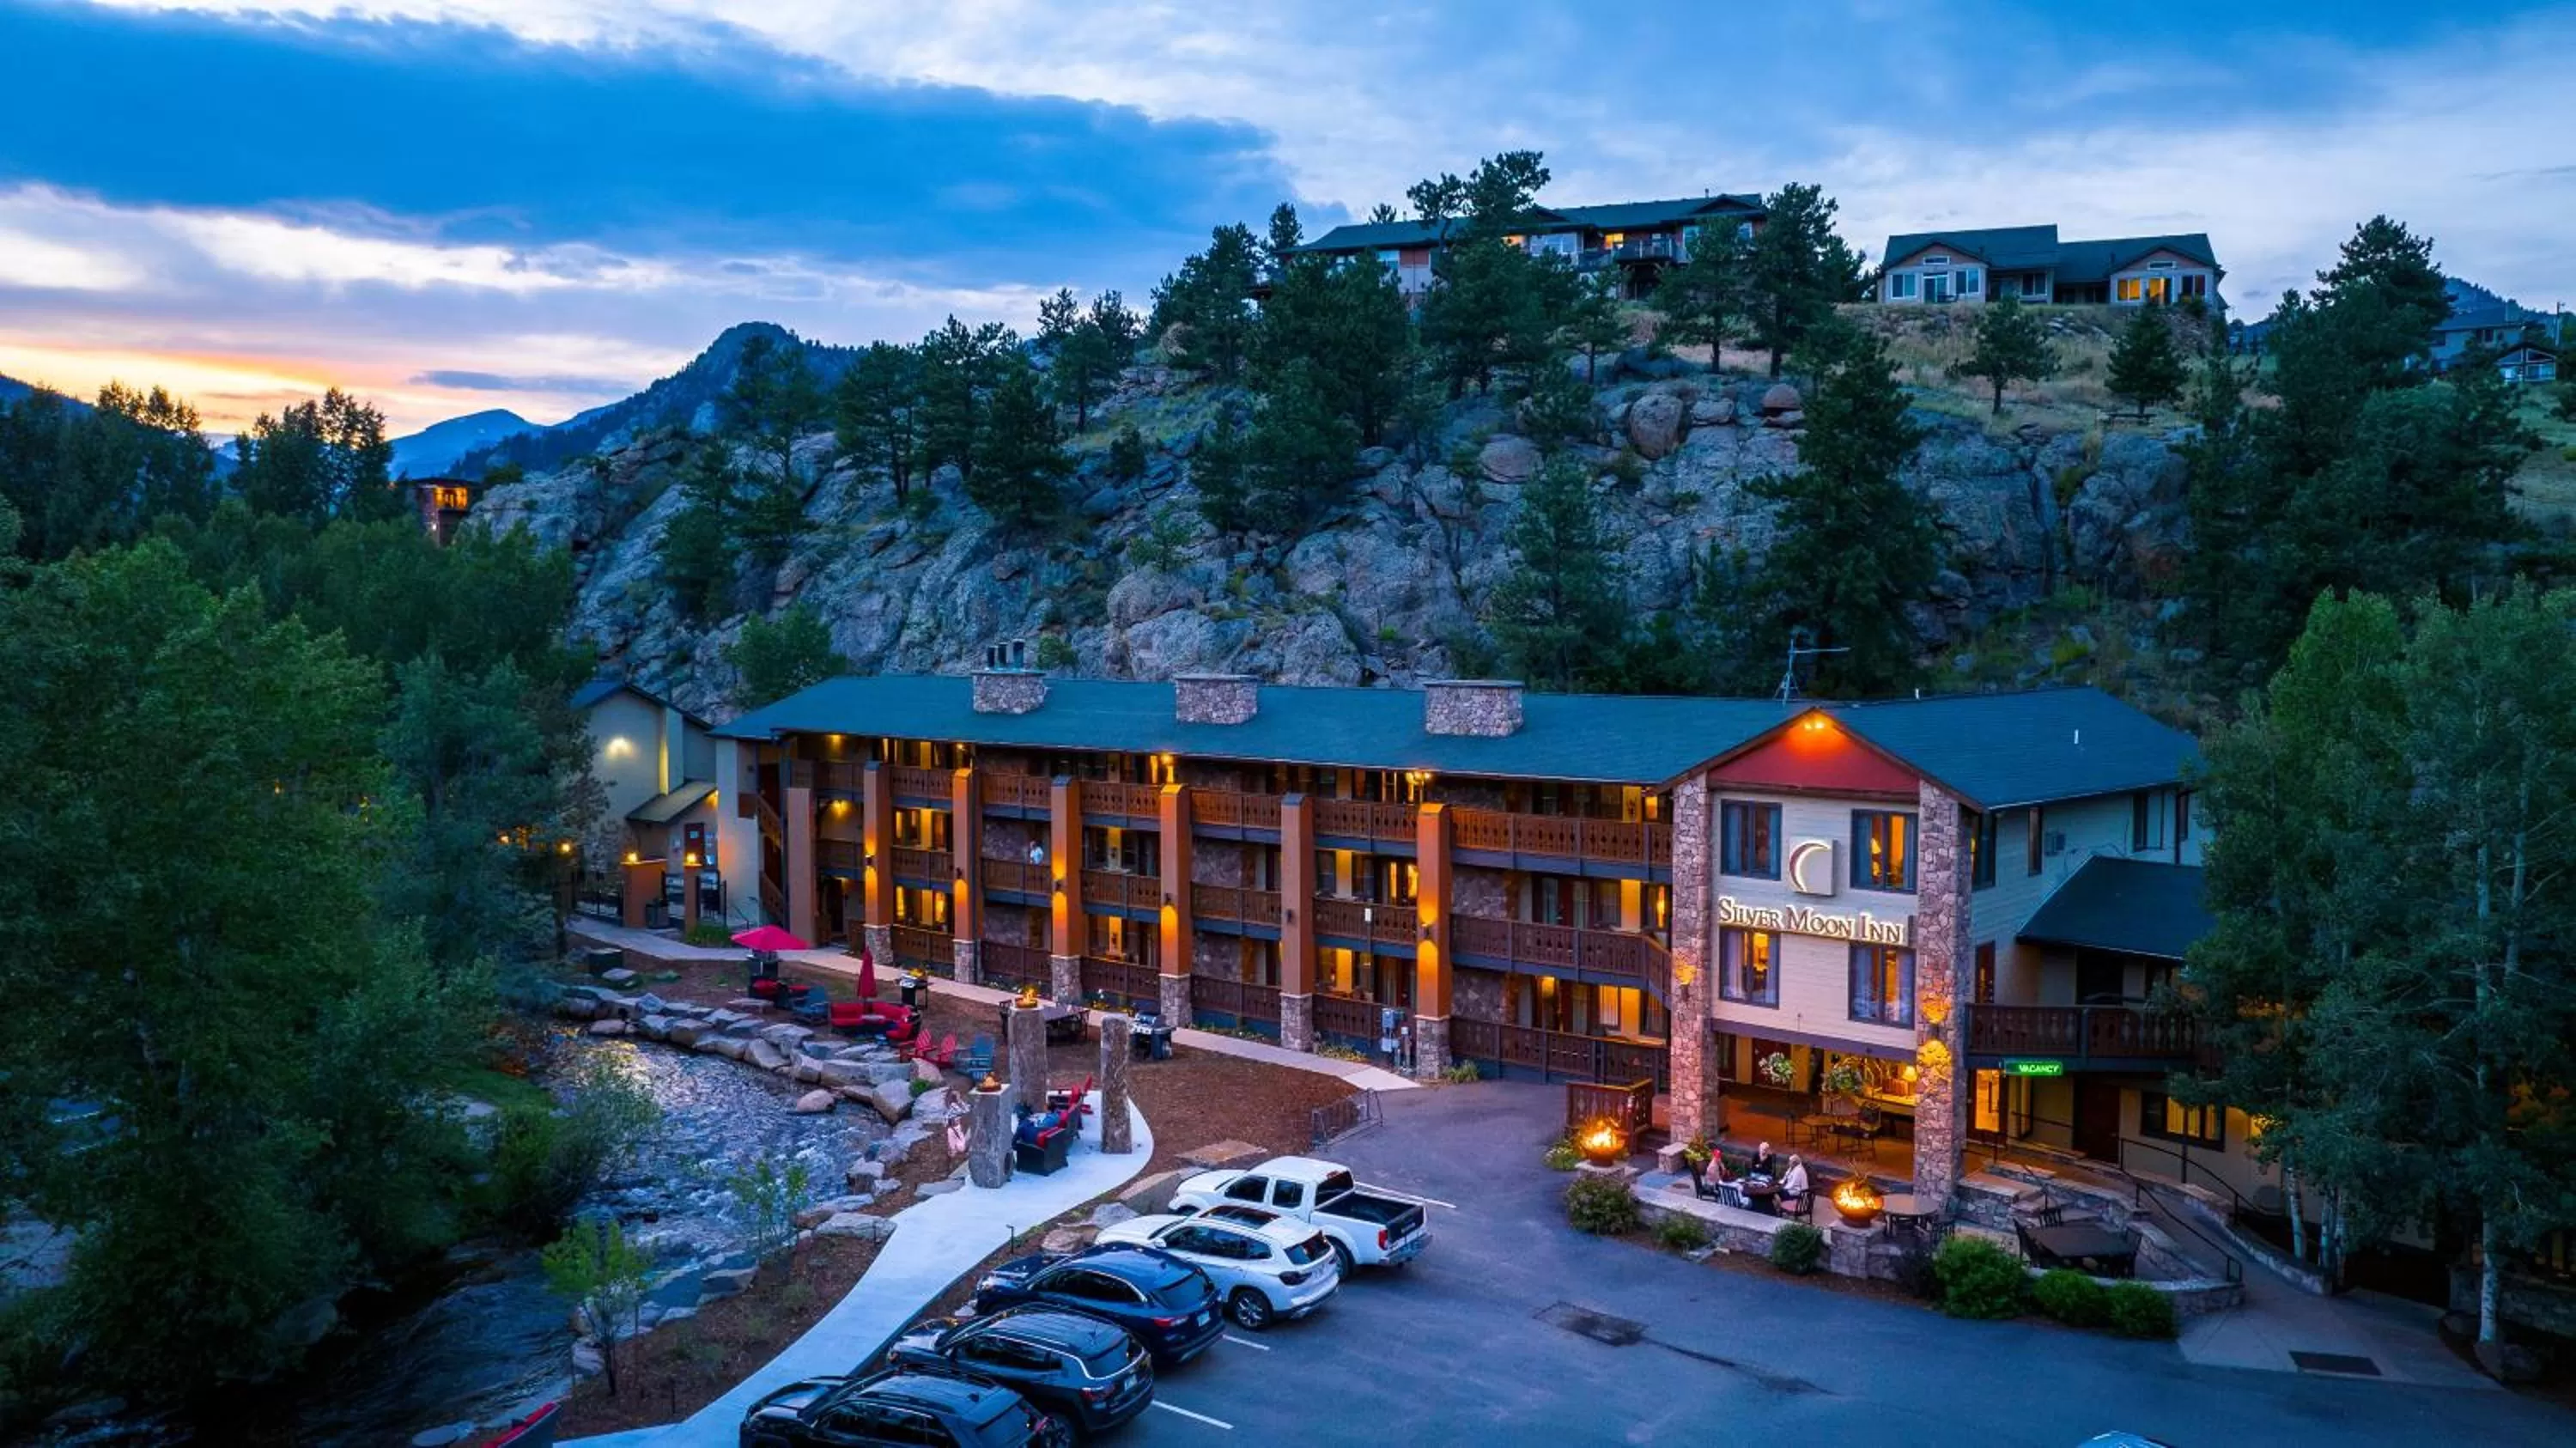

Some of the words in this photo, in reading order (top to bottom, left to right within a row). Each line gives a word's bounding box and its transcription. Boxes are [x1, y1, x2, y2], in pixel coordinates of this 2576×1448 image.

[1718, 896, 1784, 929] SILVER
[1786, 904, 1853, 940] MOON
[1858, 911, 1905, 943] INN
[2019, 1064, 2060, 1073] VACANCY
